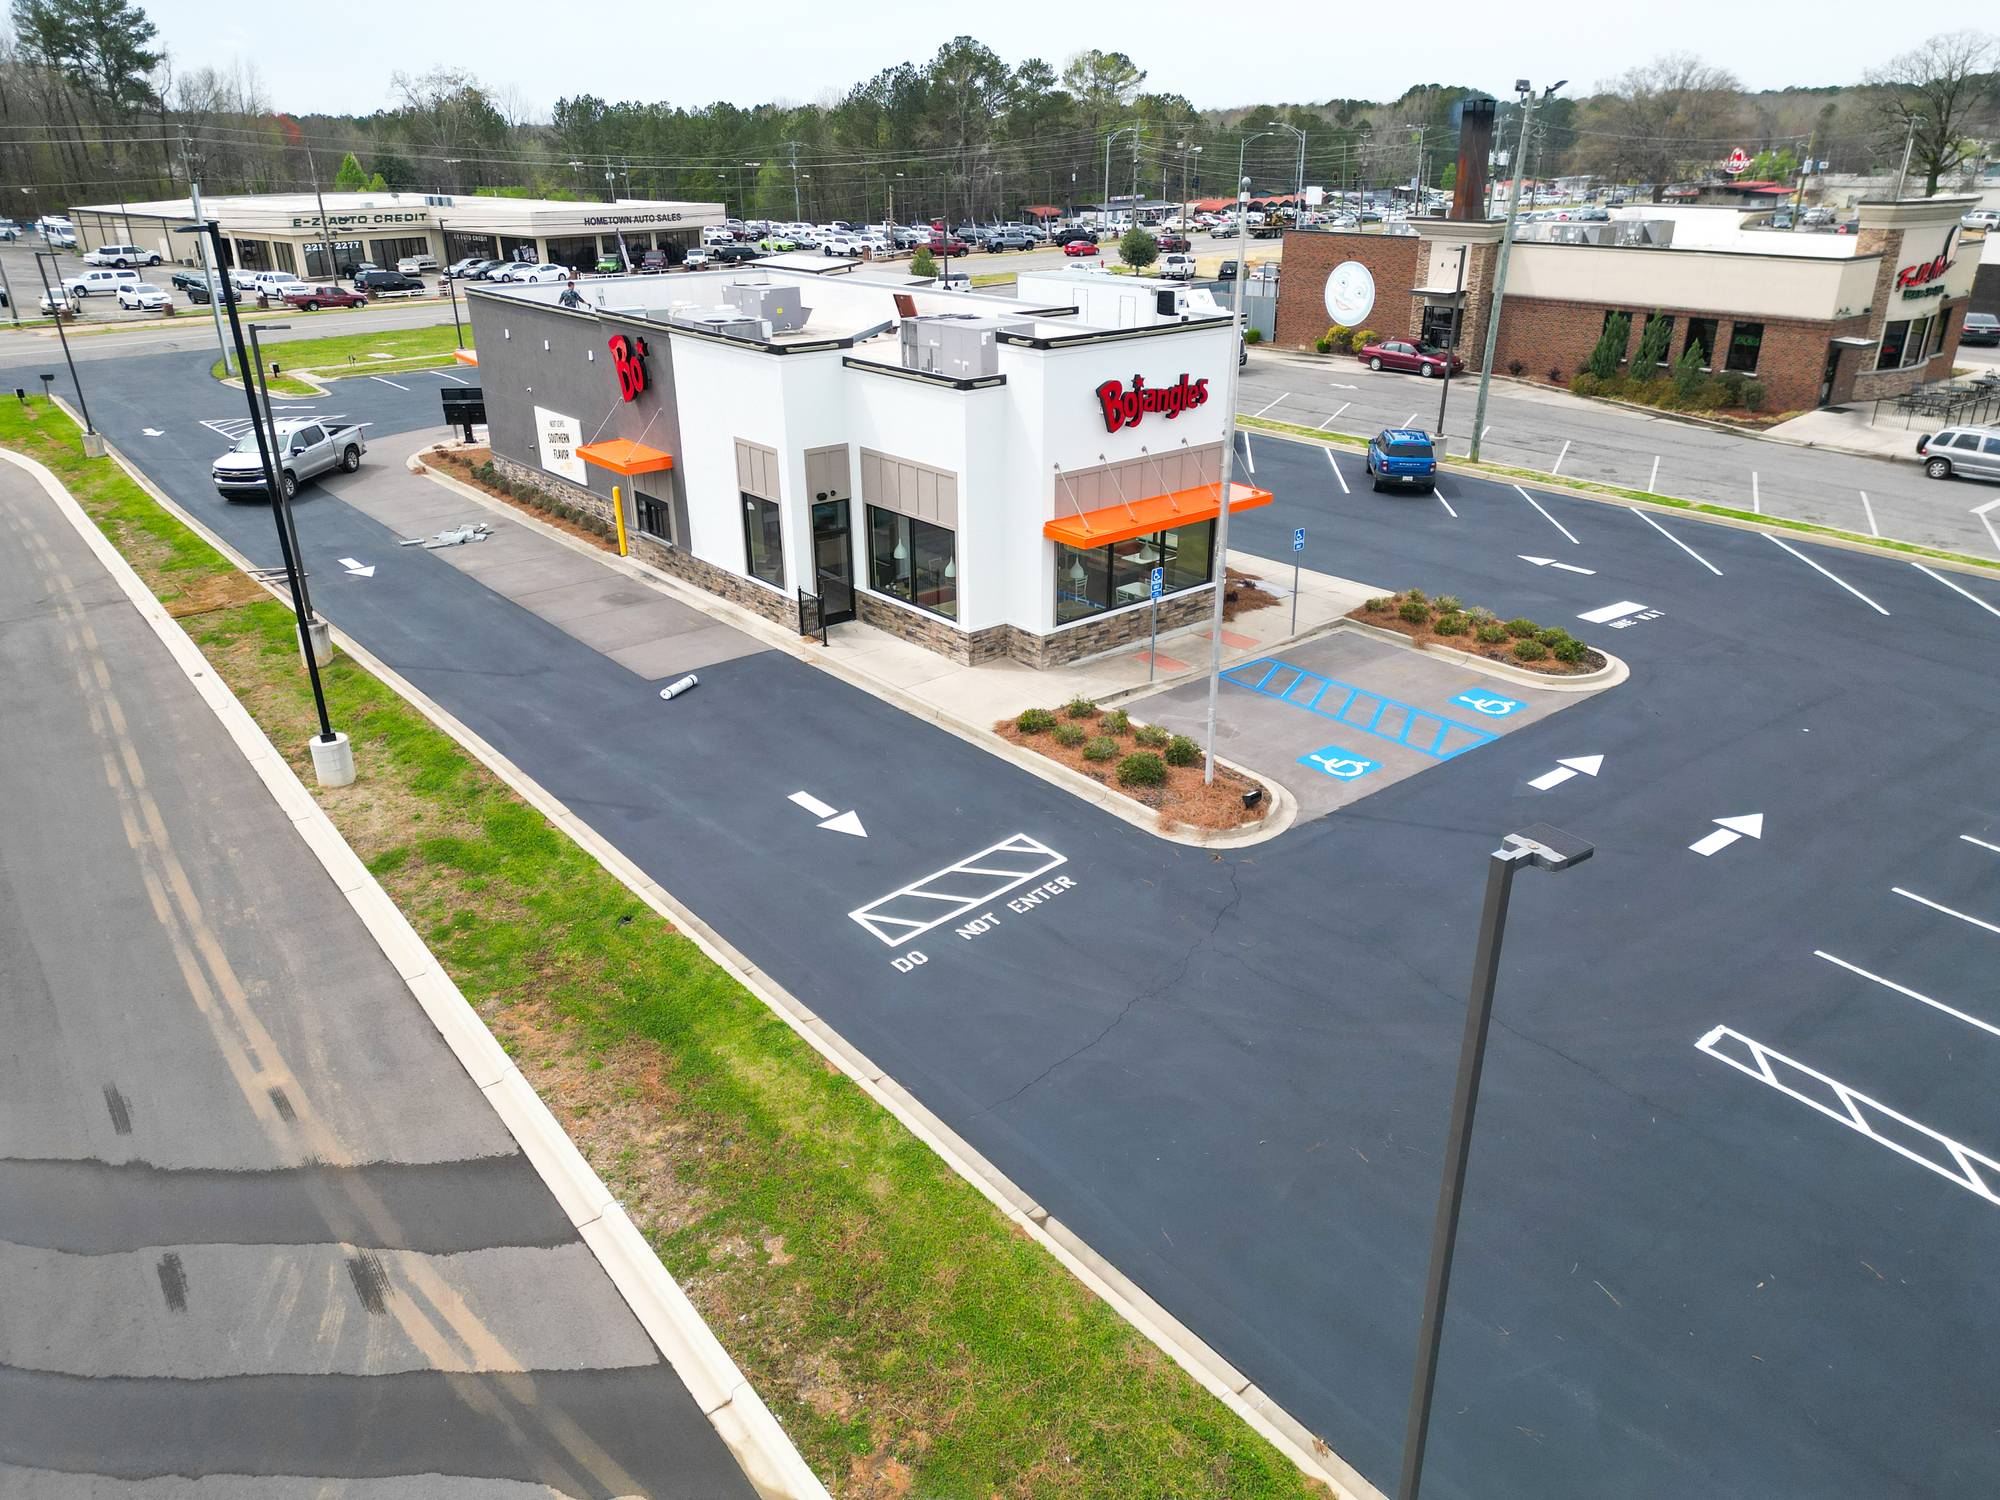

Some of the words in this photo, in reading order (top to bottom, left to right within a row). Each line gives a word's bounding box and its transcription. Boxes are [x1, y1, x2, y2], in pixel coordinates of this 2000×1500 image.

[293, 218, 320, 227] E-Z
[328, 215, 368, 225] AUTO
[374, 213, 427, 223] CREDIT
[584, 216, 632, 226] HOMETOWN
[633, 214, 655, 224] AUTO
[656, 213, 682, 222] SALES
[608, 335, 649, 402] Bo
[1096, 373, 1209, 433] Bojangles
[890, 950, 928, 974] DO
[955, 912, 1001, 941] NOT
[1006, 875, 1077, 914] ENTER
